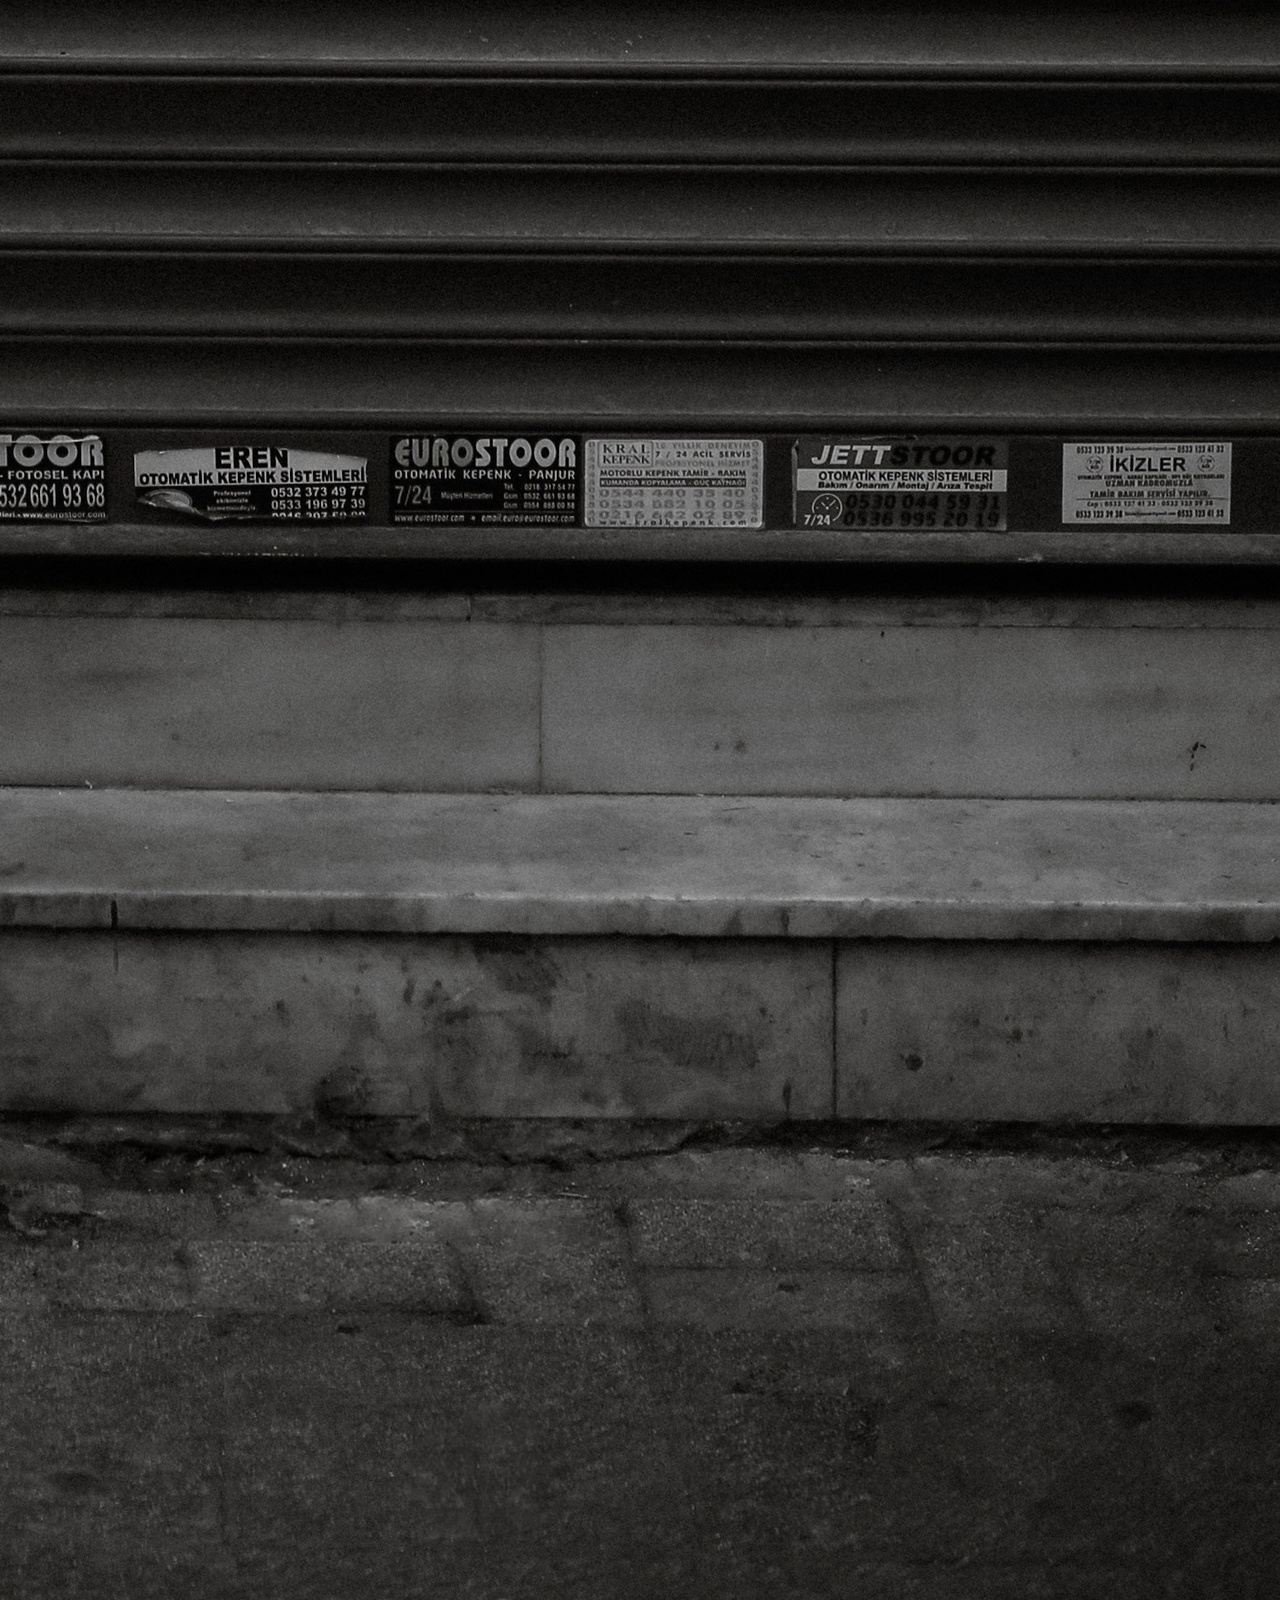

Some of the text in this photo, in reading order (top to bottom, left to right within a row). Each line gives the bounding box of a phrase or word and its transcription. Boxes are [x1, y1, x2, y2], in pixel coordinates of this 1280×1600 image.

[394, 438, 576, 468] EUROSTOOR
[603, 444, 650, 454] KRAL
[215, 447, 288, 469] EREN
[603, 455, 650, 464] KEPENK
[1110, 455, 1186, 472] İKİZLER
[7, 470, 69, 480] FOTOSEL
[73, 470, 105, 480] KAPI
[140, 467, 364, 485] OTOMATİK KEPENK SİSTEMLERİ
[394, 468, 575, 482] OTOMATİK KEPENK PANJUR
[818, 469, 993, 481] OTOMATİK KEPENK SİSTEMLERİ
[271, 486, 365, 497] 0532 373 49 77
[818, 481, 848, 489] Bakım
[897, 481, 928, 491] Montaj
[963, 481, 993, 491] Tespit
[30, 483, 57, 507] 661
[62, 483, 81, 507] 93
[86, 483, 105, 507] 68
[394, 485, 432, 506] 7/24
[271, 499, 365, 509] 0533 196 97 39
[846, 494, 896, 509] 0530
[22, 511, 106, 519] www.eurostoor.com
[394, 514, 465, 523] www.eurostoor.com
[803, 514, 831, 526] 7/24
